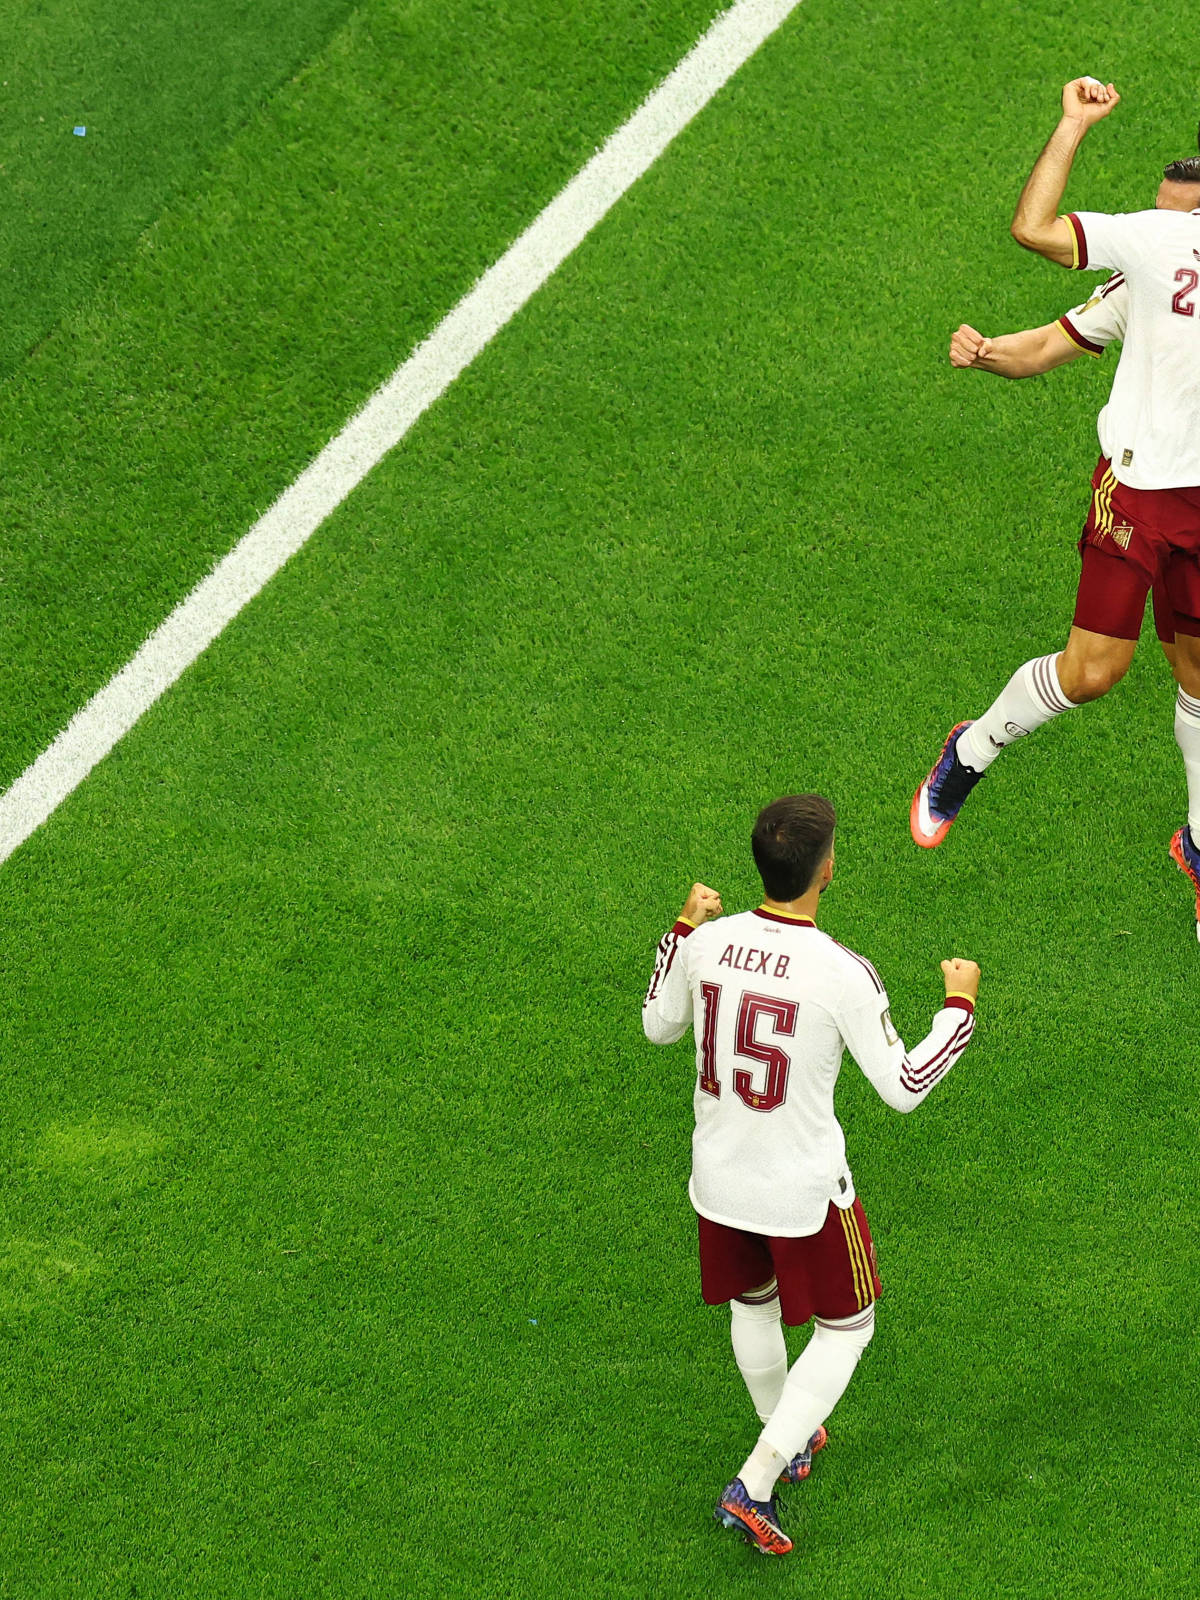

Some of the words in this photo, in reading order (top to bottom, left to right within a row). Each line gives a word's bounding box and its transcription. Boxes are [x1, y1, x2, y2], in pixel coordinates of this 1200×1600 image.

[718, 944, 772, 975] ALEX
[773, 954, 790, 980] B.
[700, 980, 800, 1113] 15
